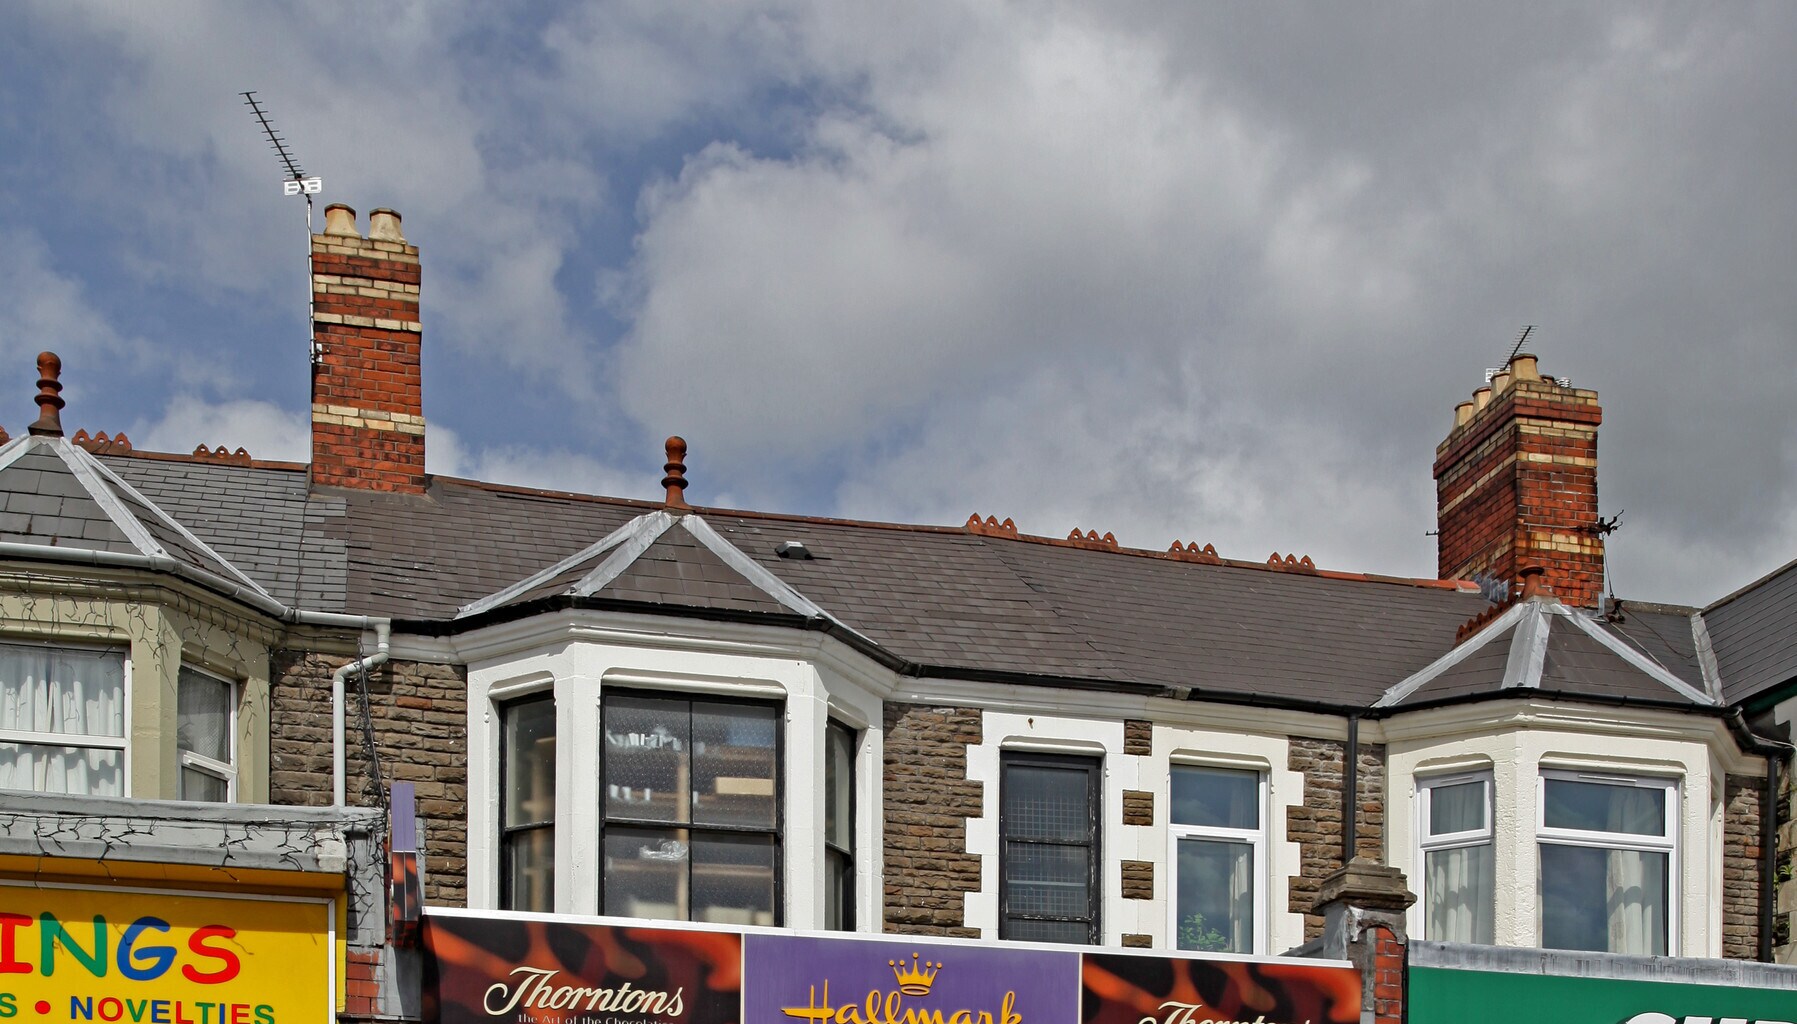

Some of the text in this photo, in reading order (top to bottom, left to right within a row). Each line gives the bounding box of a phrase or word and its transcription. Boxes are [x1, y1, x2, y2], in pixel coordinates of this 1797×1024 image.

[483, 966, 684, 1017] Thorntons
[518, 1013, 538, 1024] the
[541, 1015, 561, 1024] Art
